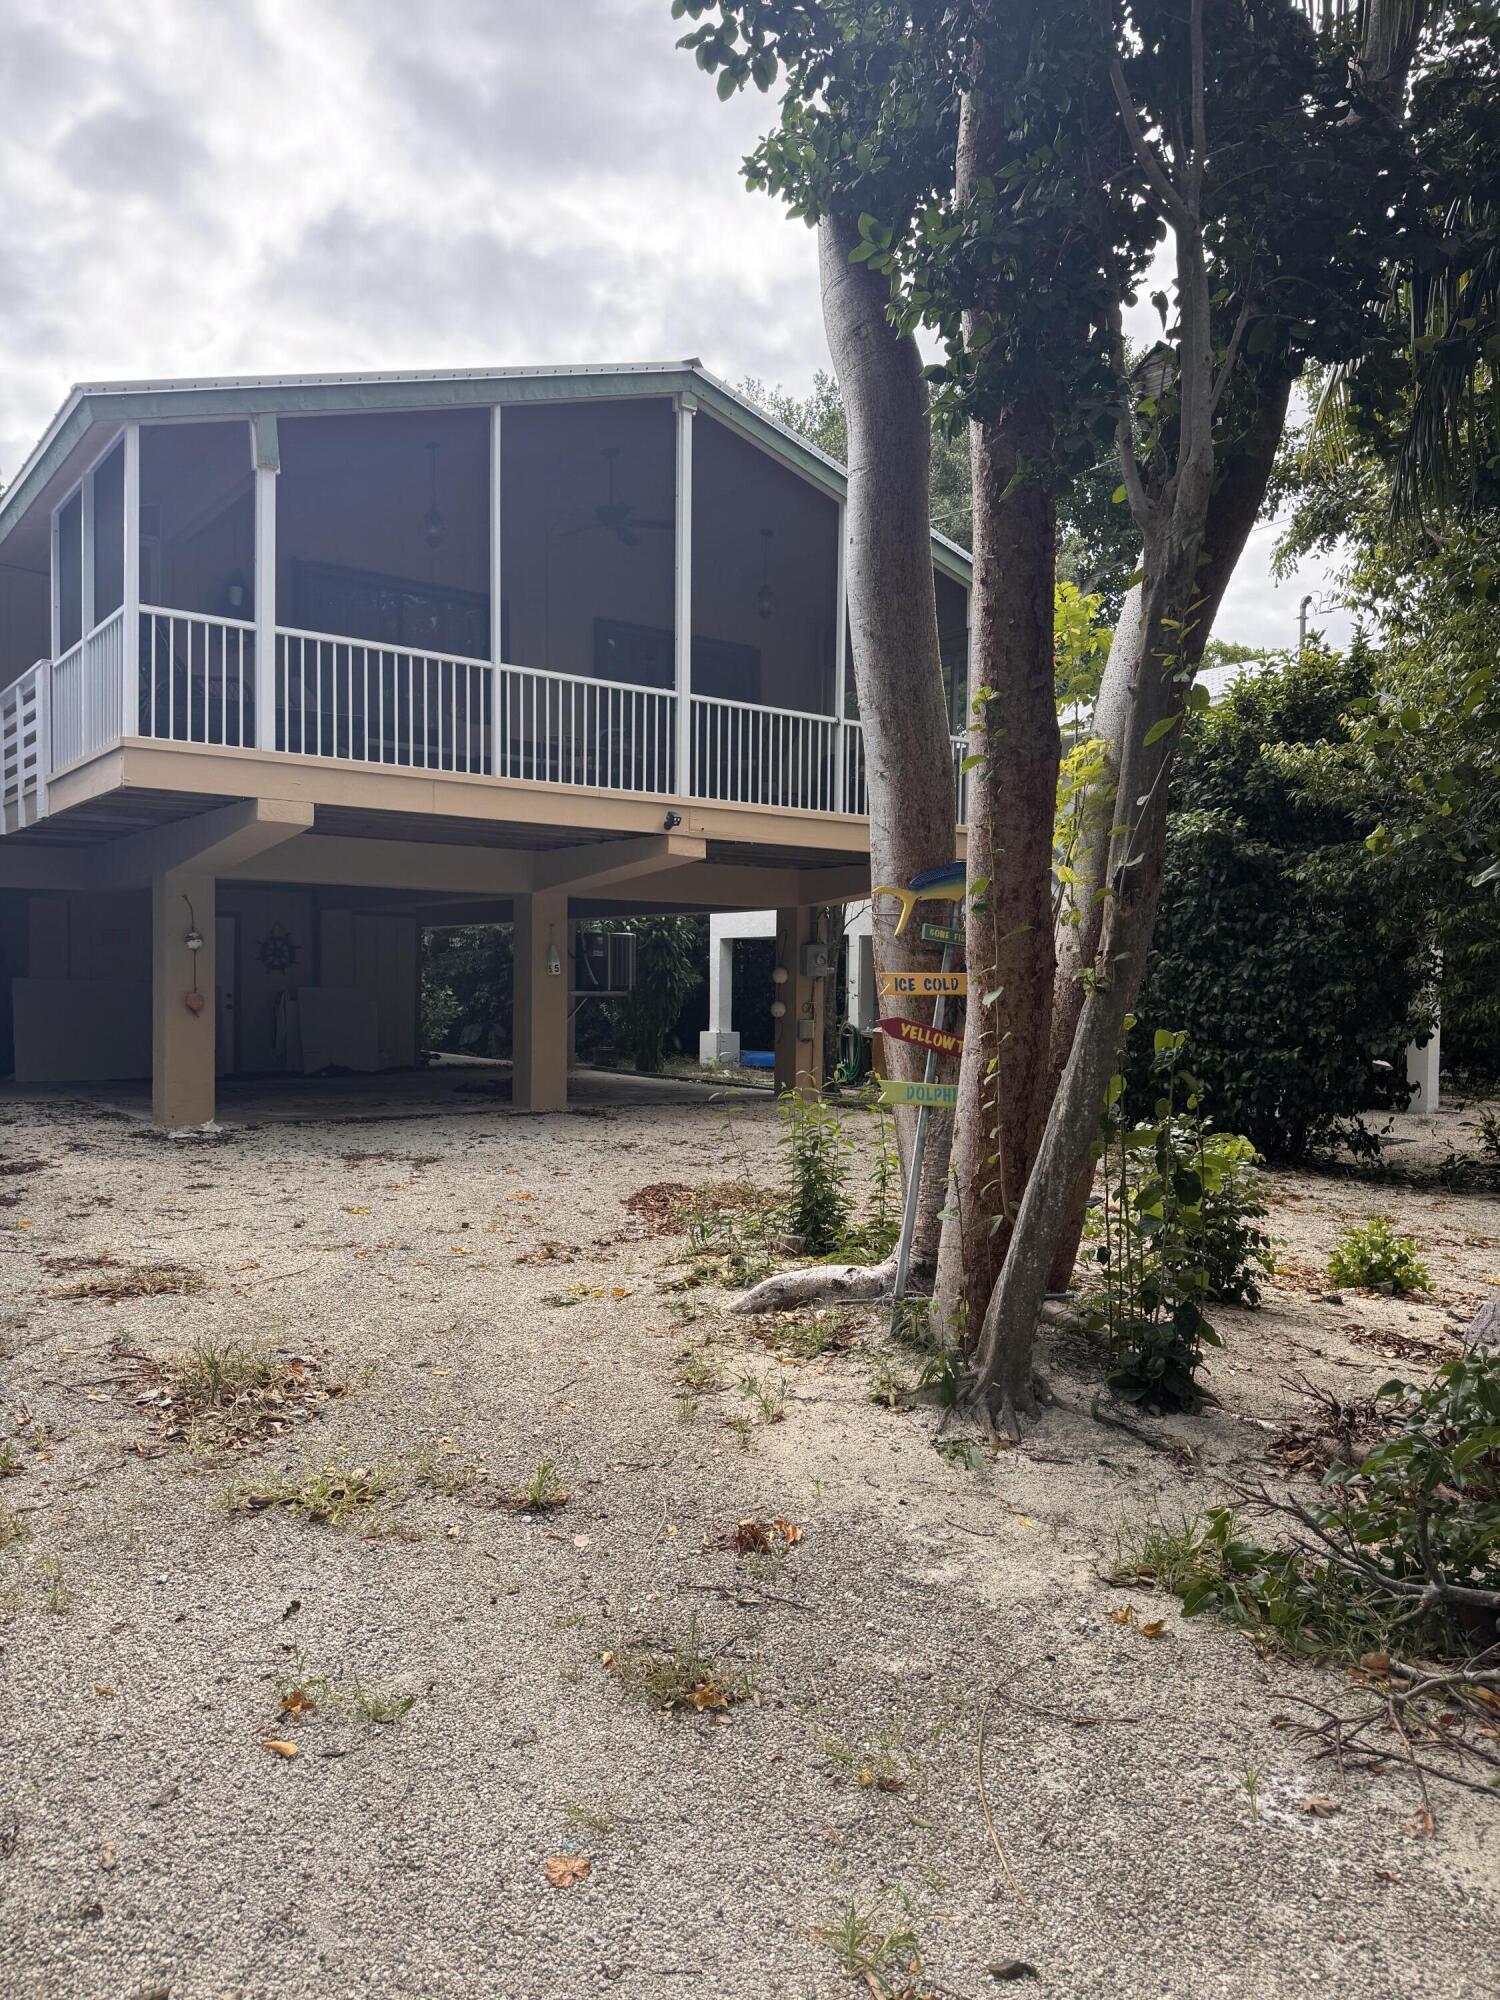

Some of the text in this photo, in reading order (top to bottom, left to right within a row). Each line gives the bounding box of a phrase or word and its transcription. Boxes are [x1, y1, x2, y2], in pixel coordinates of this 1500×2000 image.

[929, 928, 949, 939] GONE
[894, 976, 959, 992] ICE COLD
[906, 1085, 957, 1103] DOLPHI
